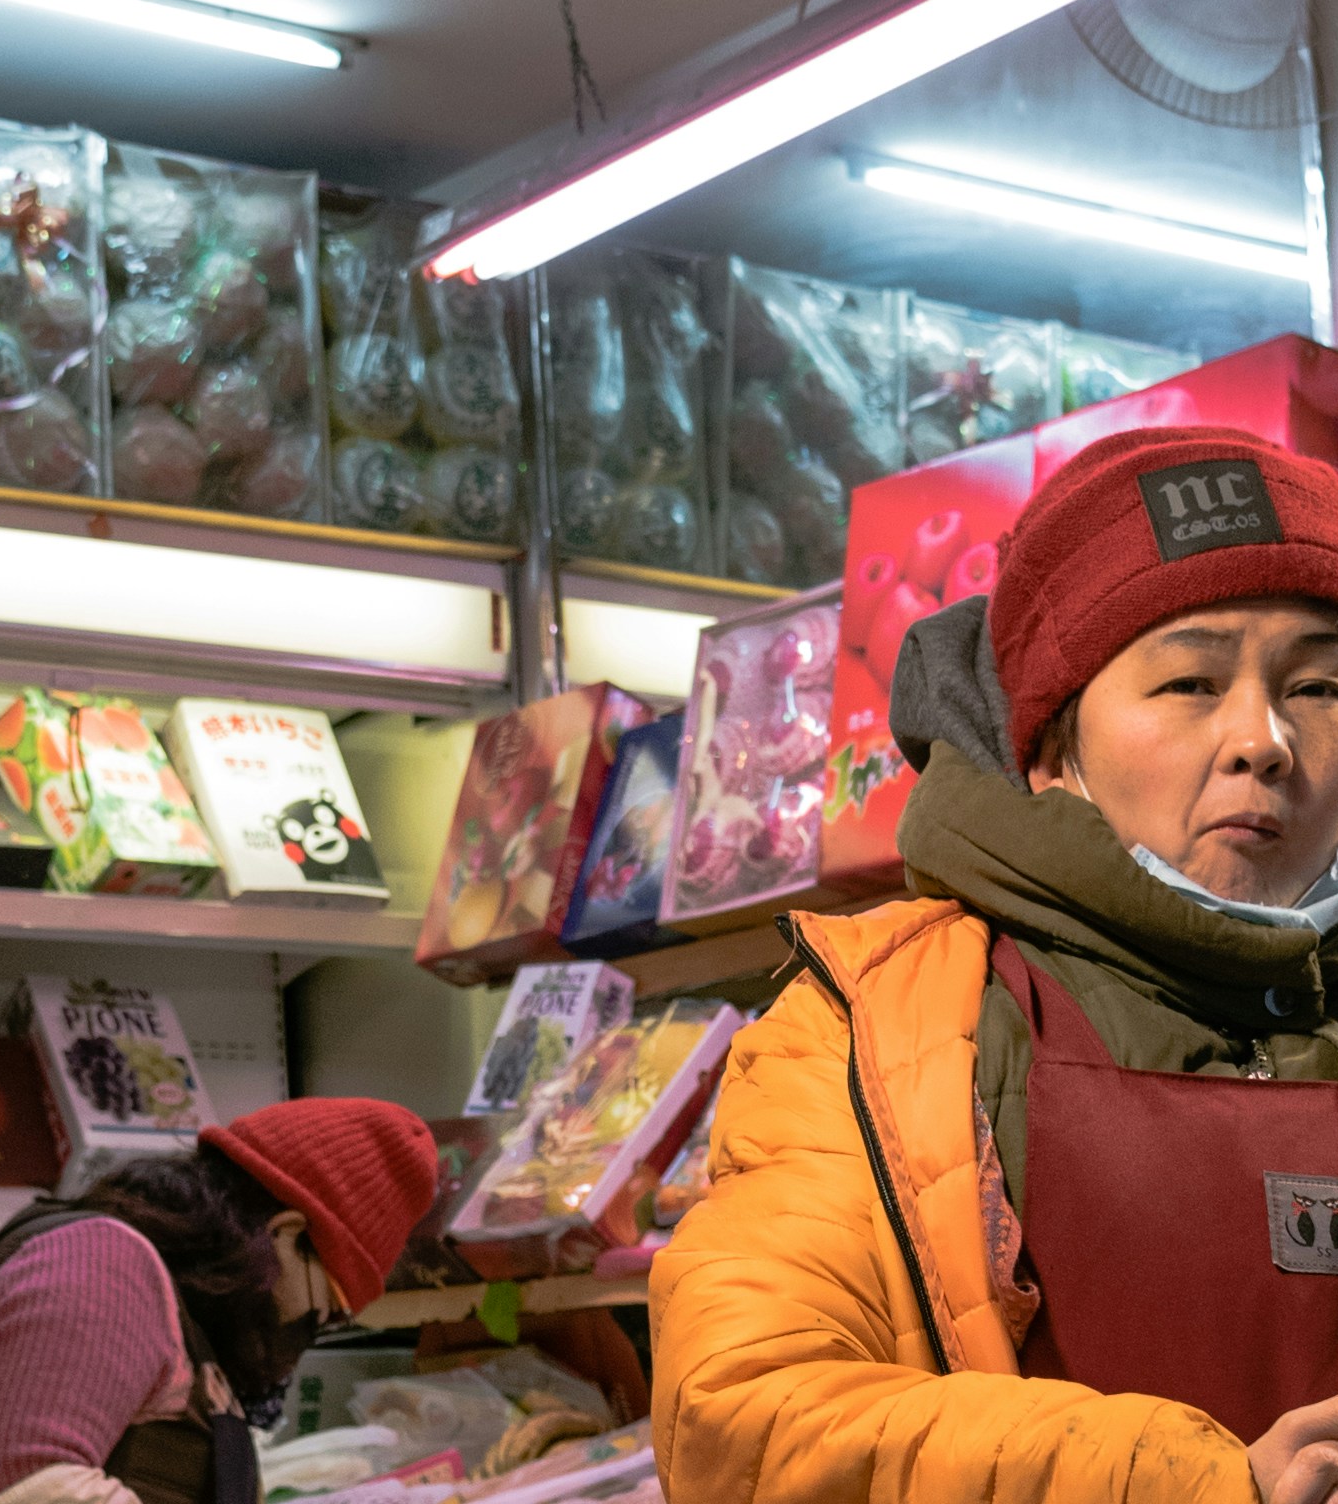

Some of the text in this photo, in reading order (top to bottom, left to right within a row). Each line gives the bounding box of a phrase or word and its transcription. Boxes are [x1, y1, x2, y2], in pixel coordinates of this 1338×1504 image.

[201, 712, 324, 752] 熊本いちご
[62, 1005, 167, 1040] PIONE
